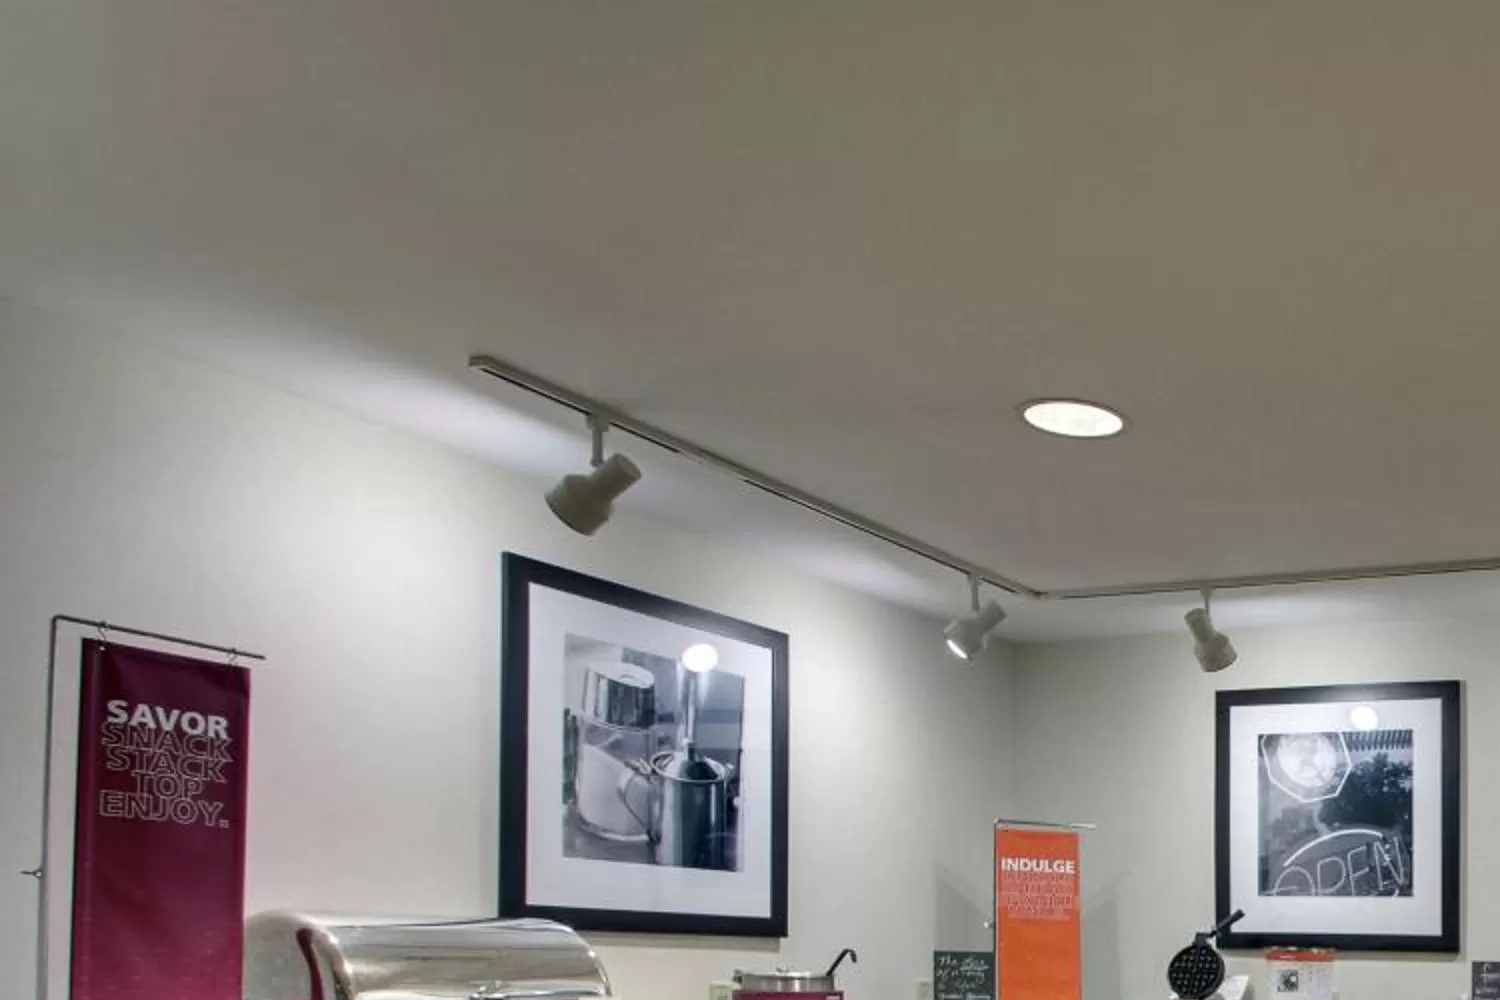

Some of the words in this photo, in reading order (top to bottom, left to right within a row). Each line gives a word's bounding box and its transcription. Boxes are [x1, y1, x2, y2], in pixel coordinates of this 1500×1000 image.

[106, 699, 228, 740] SAVOR
[100, 720, 234, 762] SNACK
[105, 745, 228, 784] STACK
[131, 769, 203, 800] TOP
[99, 789, 230, 829] ENJOY.
[1001, 856, 1076, 874] INDULGE
[1273, 835, 1405, 897] OPEN
